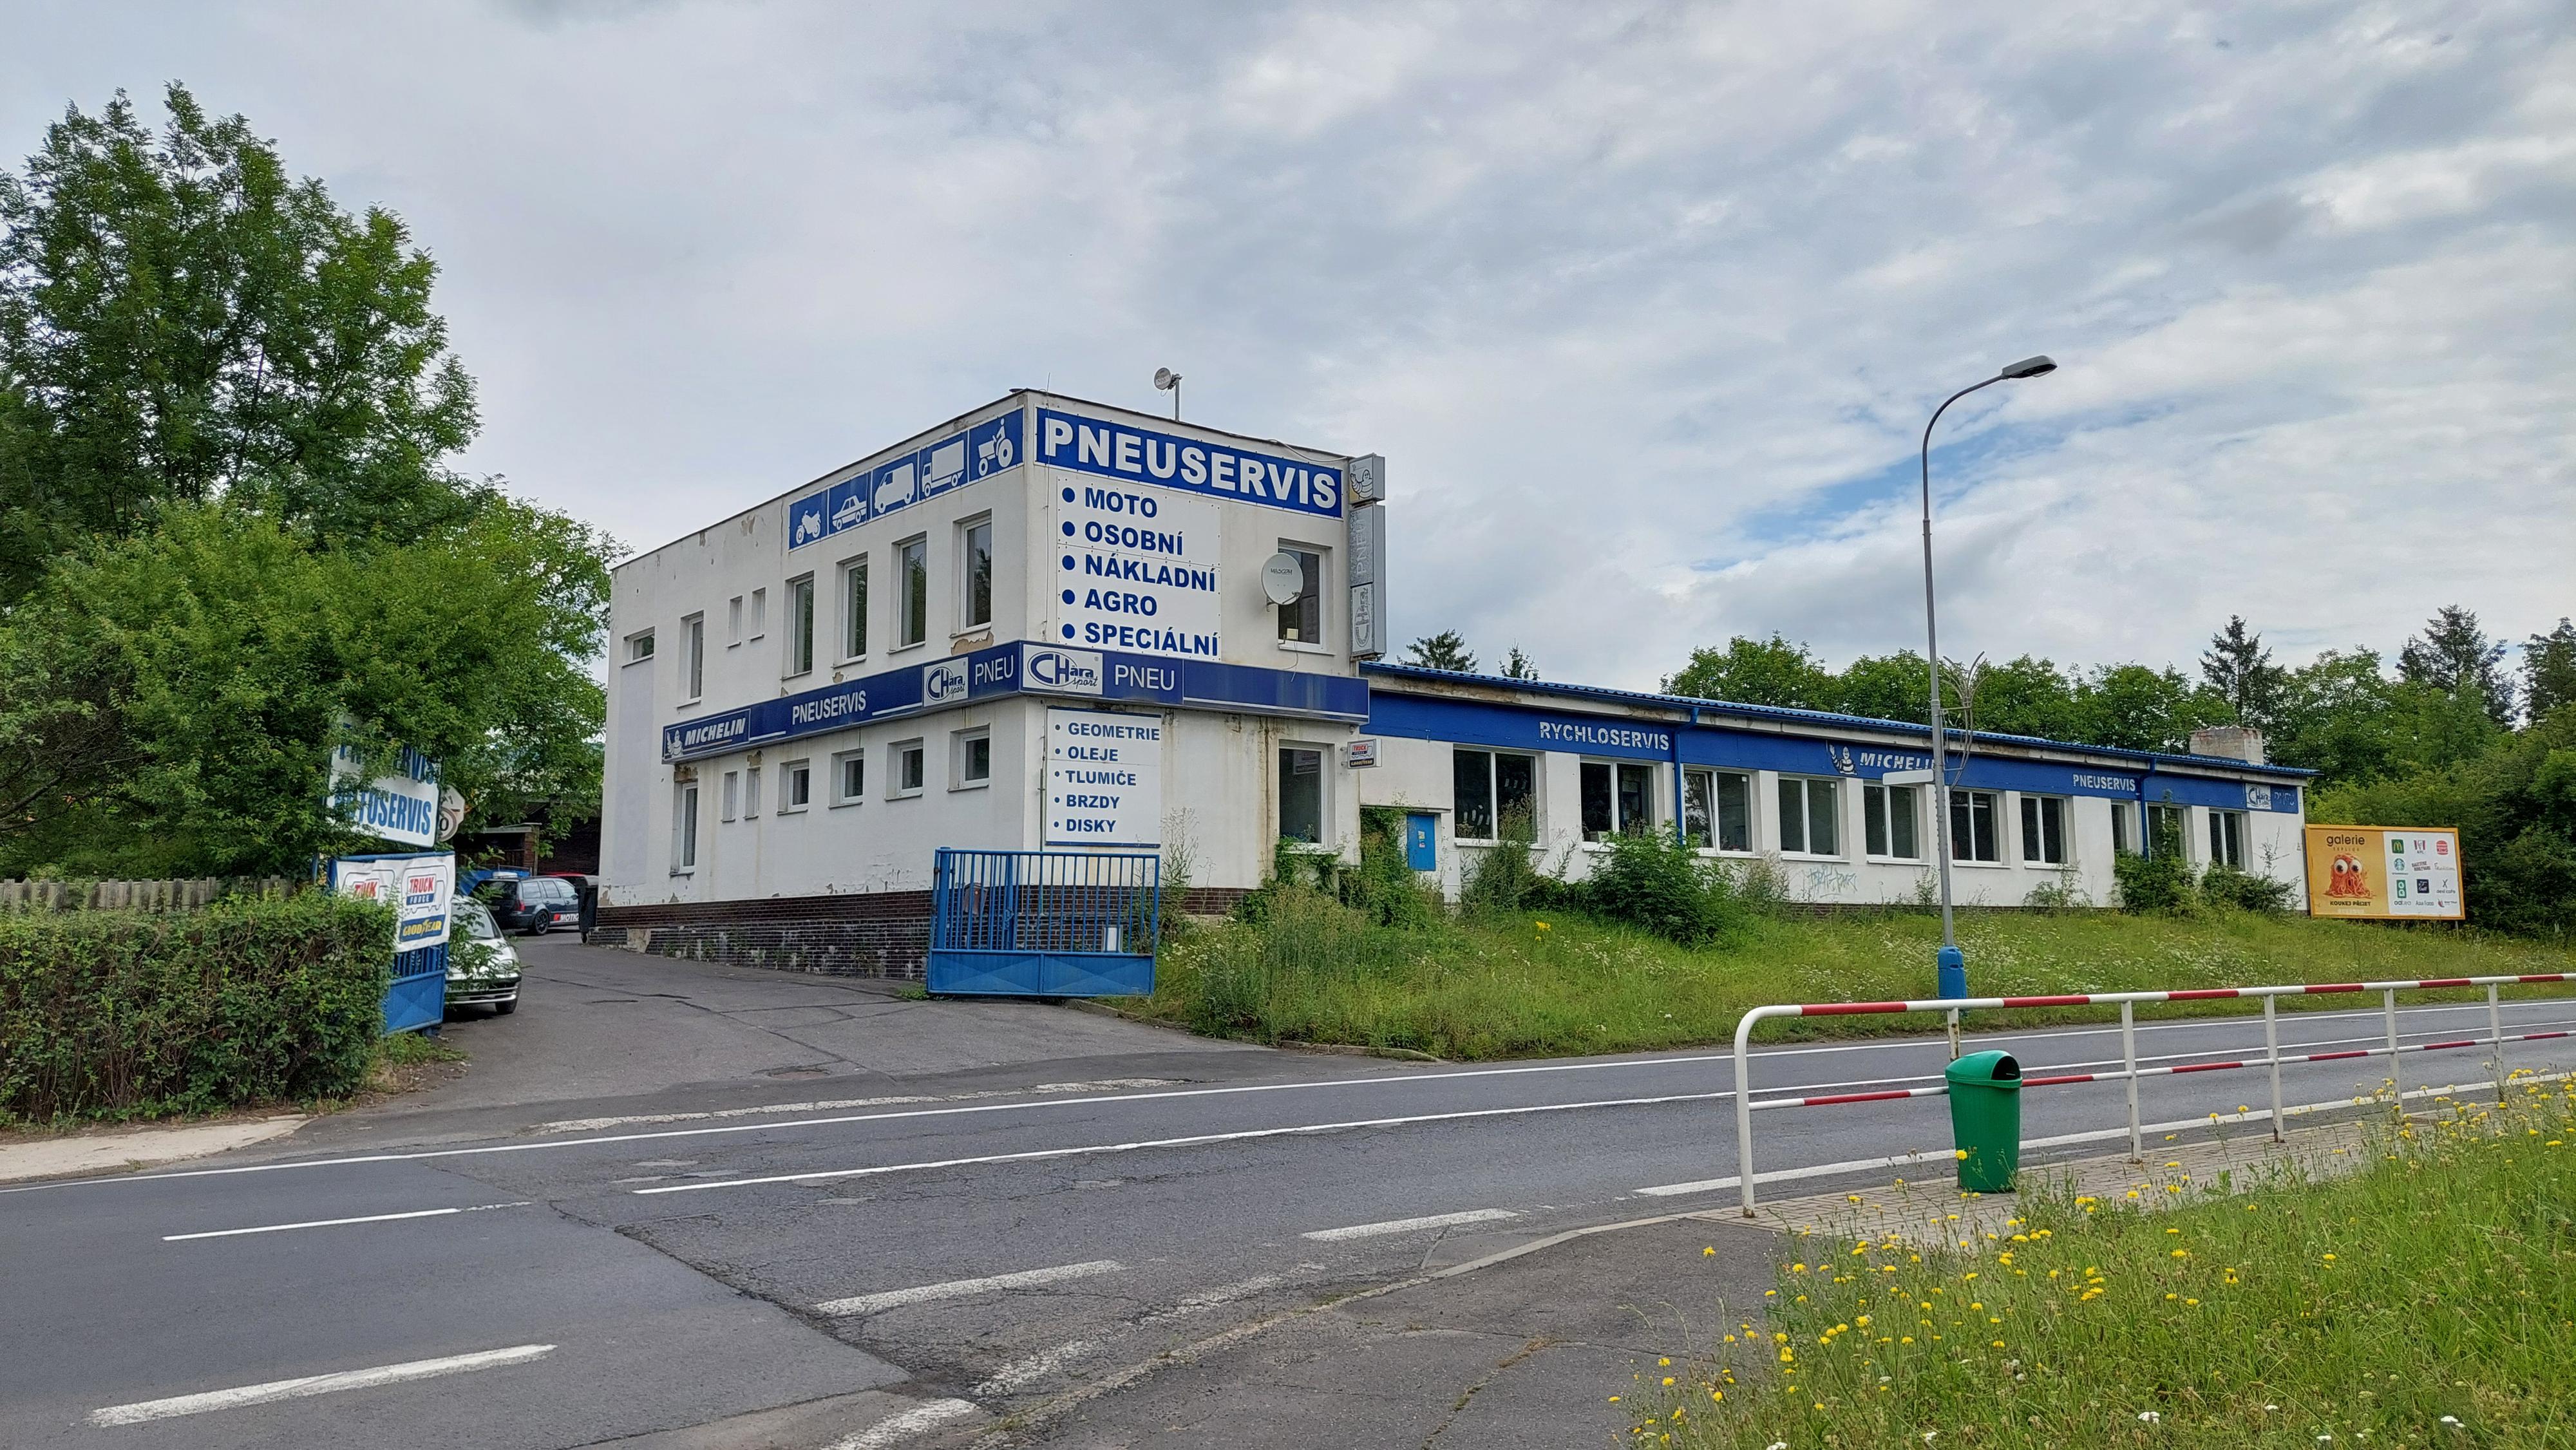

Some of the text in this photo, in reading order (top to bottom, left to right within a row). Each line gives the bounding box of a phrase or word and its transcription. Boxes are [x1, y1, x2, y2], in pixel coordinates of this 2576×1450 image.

[1045, 417, 1337, 509] PNEUSERVIS
[1085, 487, 1157, 518] MOTO
[1084, 522, 1183, 556] OSOBNÍ
[1085, 553, 1216, 592] NÁKLADNÍ
[1084, 588, 1157, 616] AGRO
[1084, 622, 1218, 656] SPECIÁLNÍ
[975, 655, 1014, 686] PNEU
[1072, 676, 1099, 690] sport
[1115, 663, 1175, 691] PNEU
[792, 690, 866, 725] PNEUSERVIS
[685, 717, 746, 746] MICHELIN
[1068, 722, 1160, 740] GEOMETRIE
[1539, 721, 1669, 751] RYCHLOSERVIS
[1068, 746, 1119, 761] OLEJE
[1065, 770, 1137, 786] TLUMIČE
[2072, 774, 2136, 791] PNEUSERVIS
[334, 786, 431, 836] TOSERVIS
[1066, 794, 1120, 809] BRZDY
[1066, 818, 1116, 832] DISKY
[2326, 834, 2365, 847] galerie
[410, 877, 434, 894] TRUCK
[410, 895, 430, 904] FORCE
[402, 919, 442, 936] GOODYEAR
